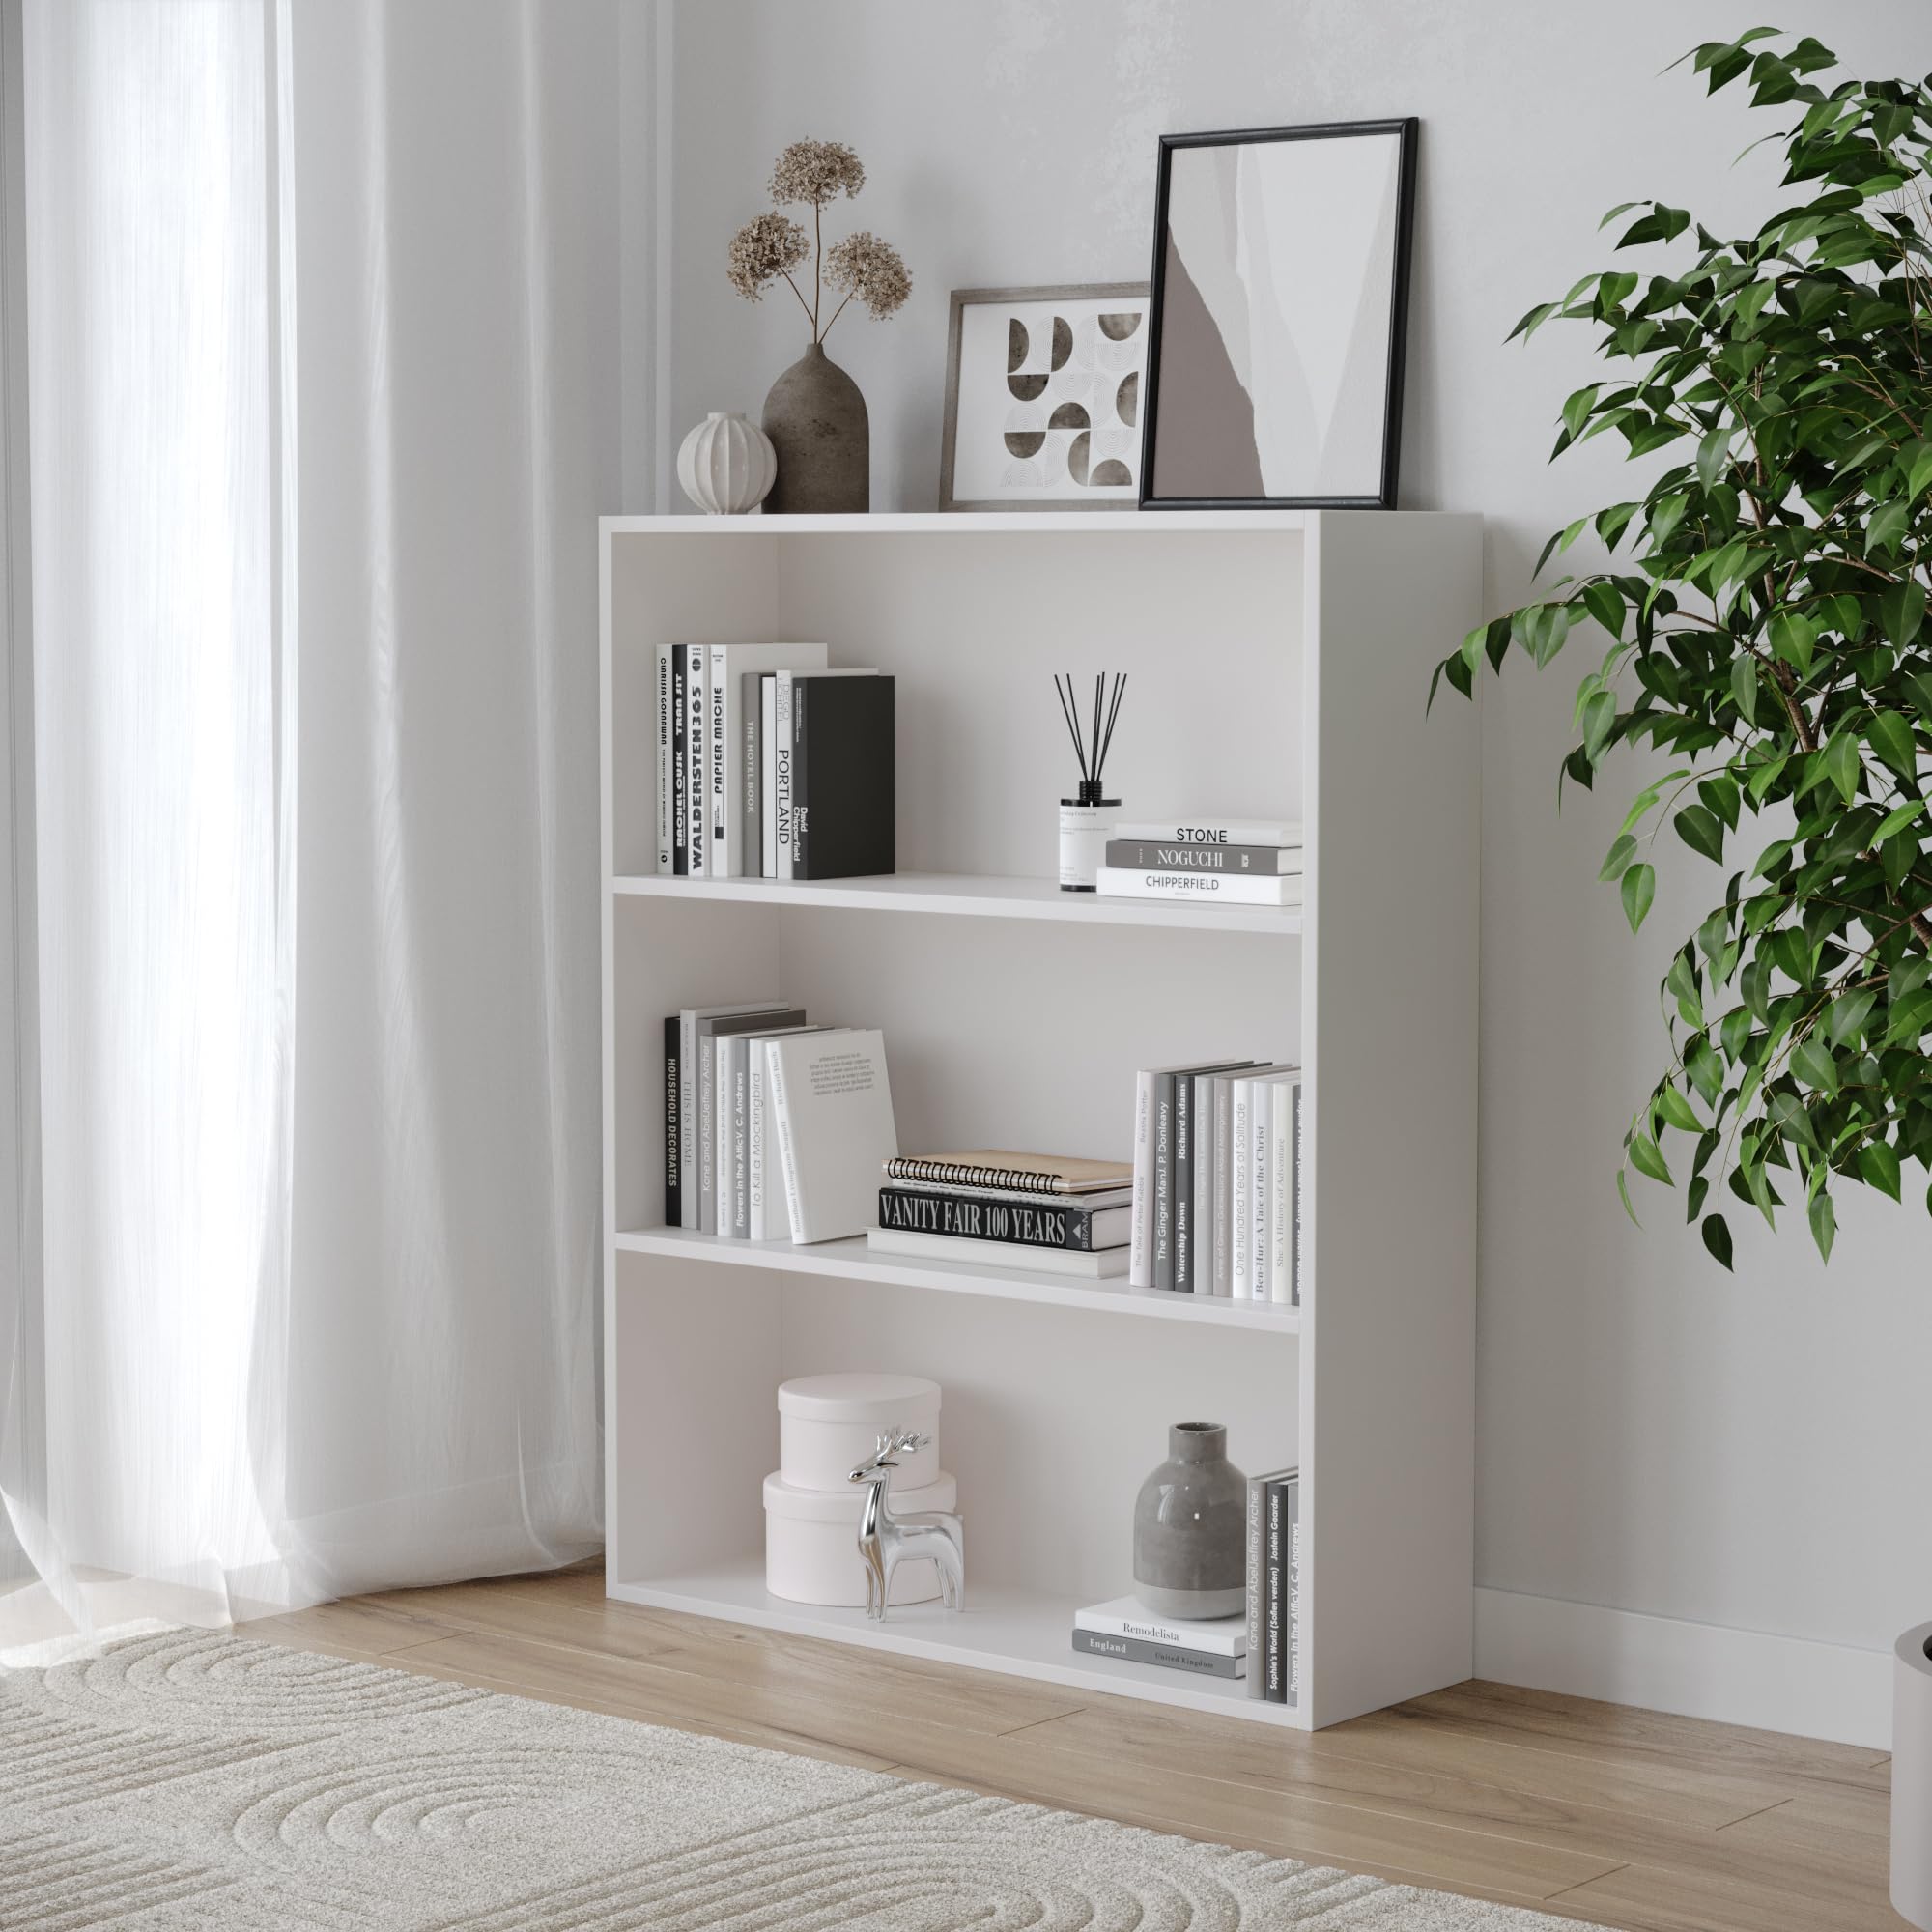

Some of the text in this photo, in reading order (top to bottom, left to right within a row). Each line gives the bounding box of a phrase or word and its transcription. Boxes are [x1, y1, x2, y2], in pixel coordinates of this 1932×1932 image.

[779, 750, 789, 844] PORTLAND
[800, 807, 809, 833] David
[1176, 828, 1228, 843] STONE
[1157, 849, 1224, 867] NOGUCHI
[1145, 875, 1219, 890] CHIPPERFIELD
[685, 1113, 692, 1123] IS
[753, 1073, 763, 1156] Mockingbird
[1159, 1101, 1169, 1152] Donleavy
[754, 1159, 761, 1169] a
[1160, 1155, 1167, 1164] P.
[737, 1180, 744, 1189] in
[1236, 1103, 1246, 1276] One Hundred Years of Solitude
[1257, 1185, 1264, 1197] of
[753, 1192, 761, 1208] To
[880, 1194, 1065, 1245] VANITY FAIR 100 YEARS
[1159, 1201, 1169, 1237] Ginger
[1257, 1227, 1264, 1236] A
[1179, 1233, 1187, 1283] Watership
[1250, 1489, 1259, 1527] Archer
[1271, 1567, 1280, 1600] verden)
[1270, 1602, 1279, 1629] (Sofies
[1122, 1622, 1179, 1642] Remodelista
[1249, 1622, 1258, 1650] Kane
[1090, 1638, 1127, 1654] England
[1154, 1651, 1214, 1669] United Kingdom
[1270, 1656, 1279, 1690] Sophie's
